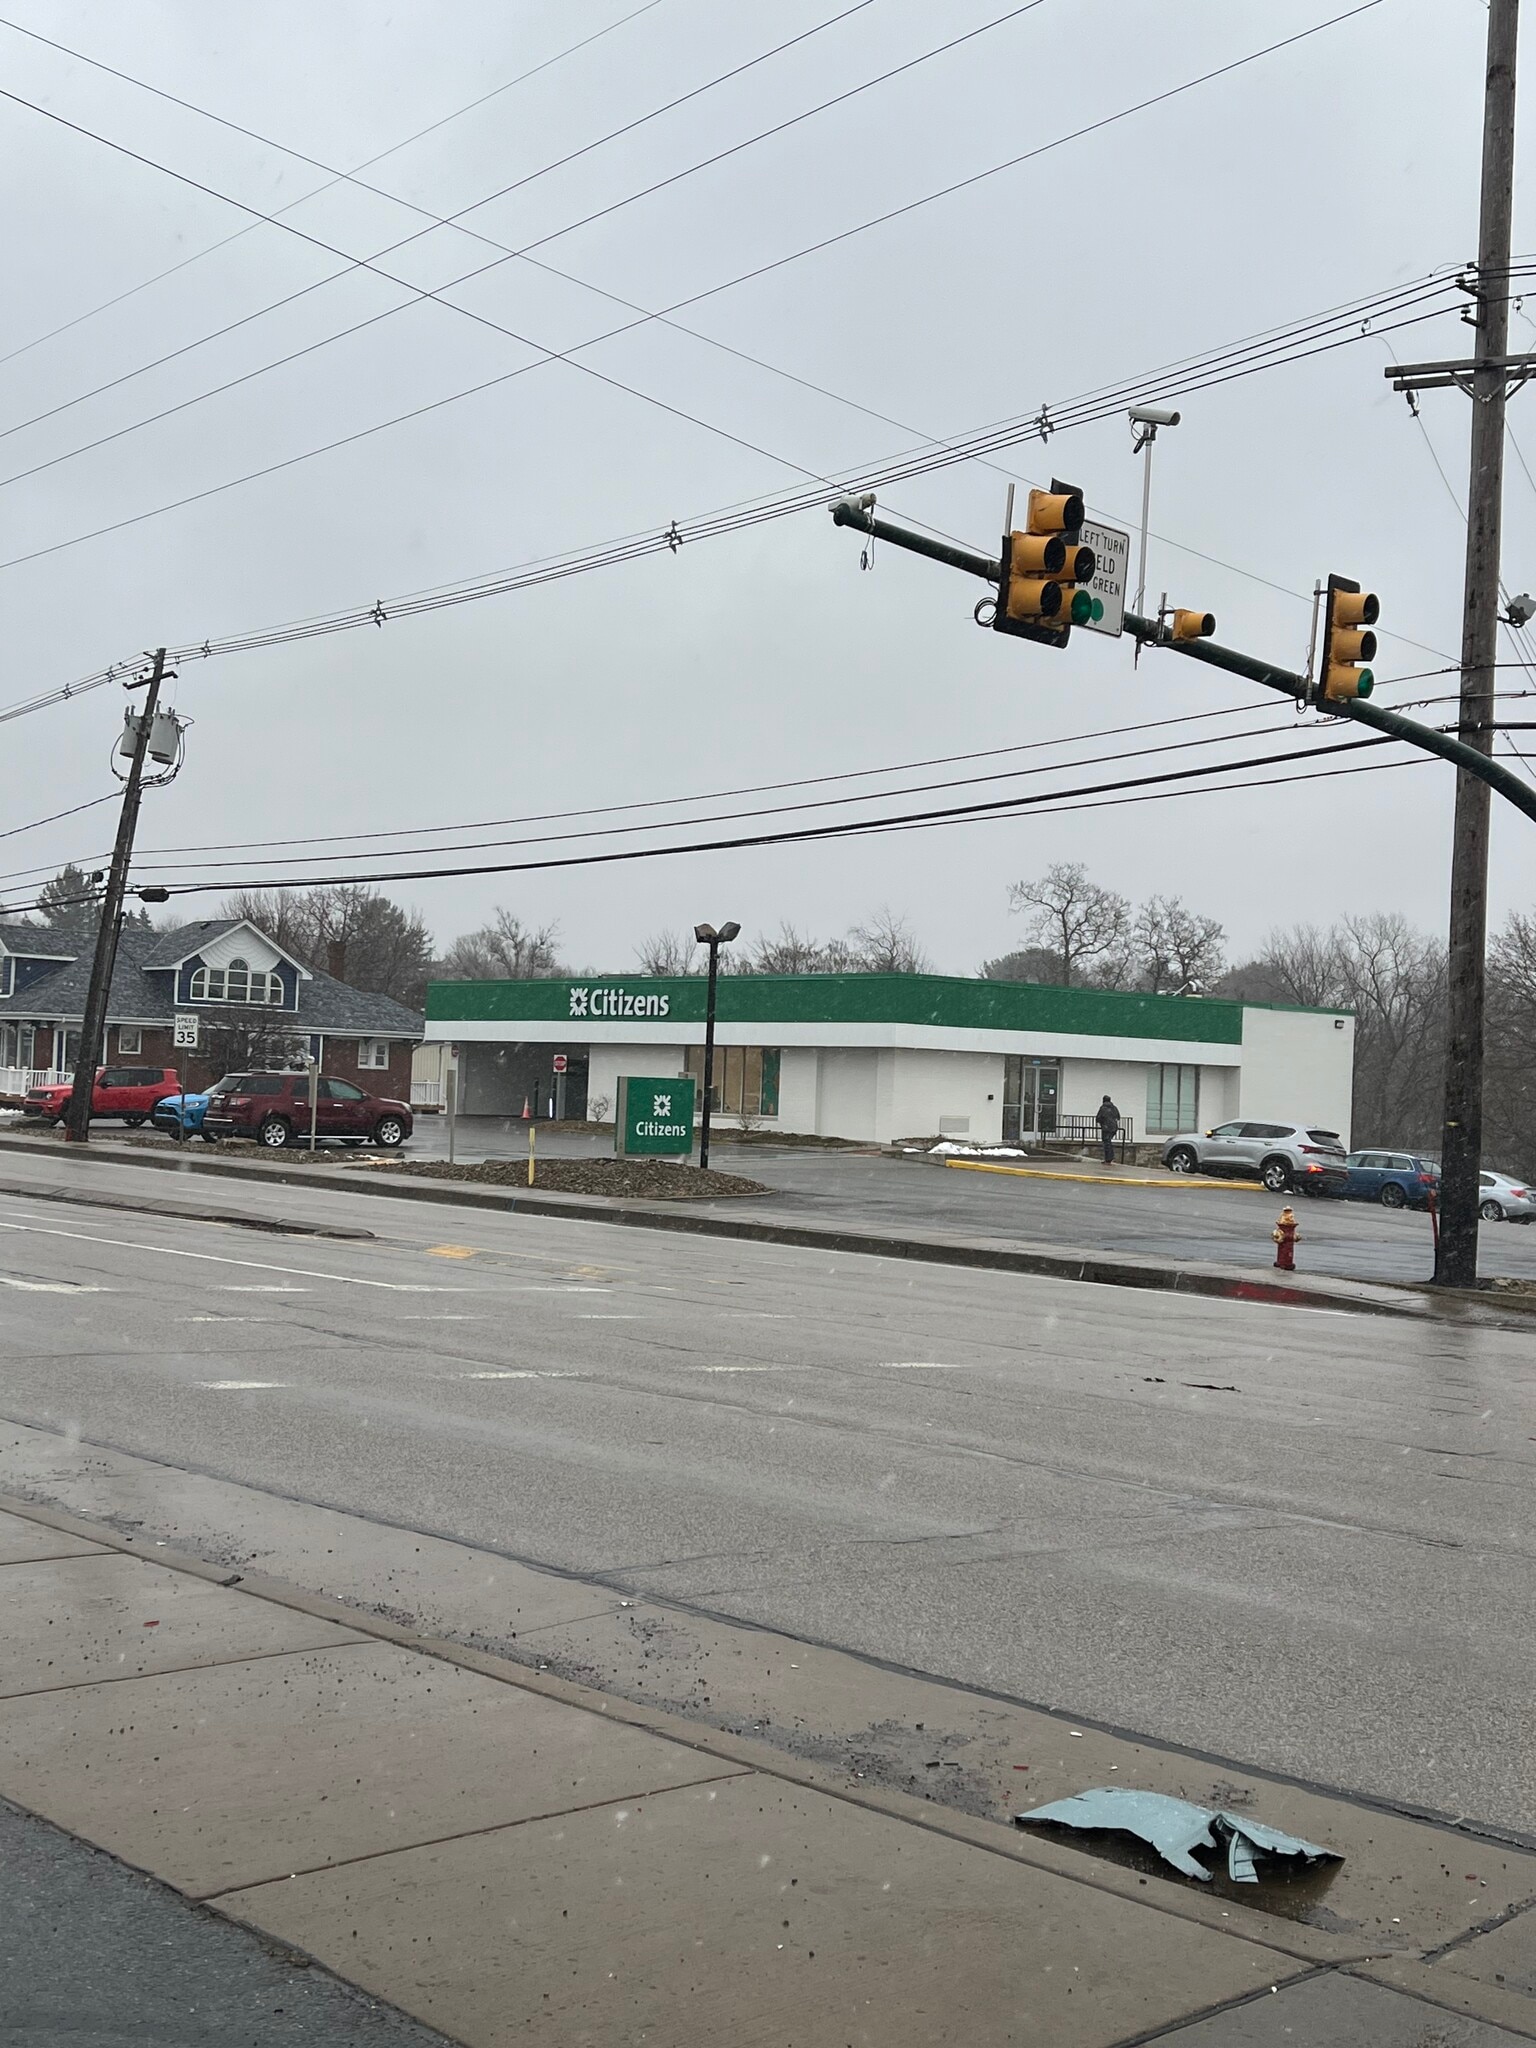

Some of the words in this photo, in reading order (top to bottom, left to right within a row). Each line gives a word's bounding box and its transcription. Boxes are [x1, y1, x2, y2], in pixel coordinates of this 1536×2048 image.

[1080, 529, 1100, 547] LEFT
[1103, 534, 1125, 555] TURN
[1094, 554, 1115, 575] ELD
[1093, 576, 1120, 597] GREEN
[590, 988, 669, 1016] Citizens
[177, 1031, 195, 1044] 35
[636, 1121, 686, 1136] Citizens
